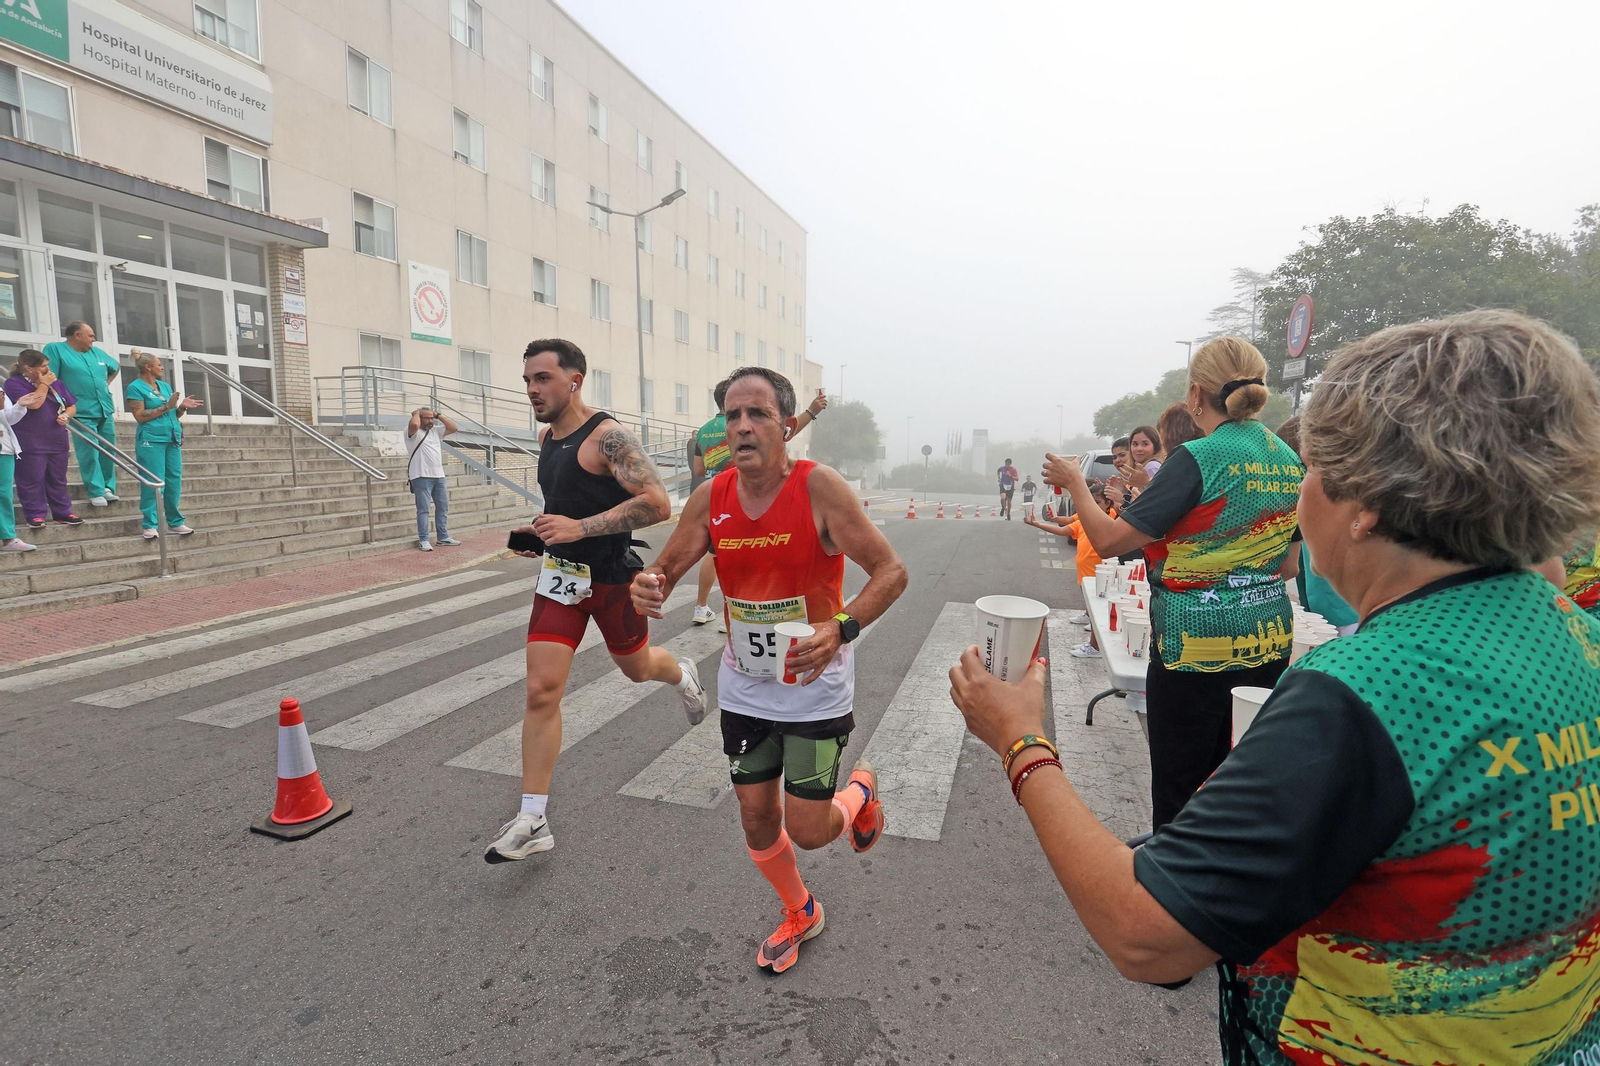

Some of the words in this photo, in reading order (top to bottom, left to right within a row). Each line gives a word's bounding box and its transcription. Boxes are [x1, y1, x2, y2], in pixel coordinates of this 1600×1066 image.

[8, 11, 20, 20] de
[21, 16, 63, 38] Andalucía
[82, 22, 142, 57] Hospital
[144, 50, 221, 91] Universitario
[224, 86, 237, 98] de
[239, 93, 266, 111] Jerez
[83, 44, 142, 78] Hospital
[145, 70, 196, 100] Materno
[206, 96, 244, 120] Infantil
[1228, 463, 1241, 477] X
[1244, 462, 1281, 476] MILLA
[1246, 480, 1280, 493] PILAR
[718, 532, 792, 550] ESPAÑA
[758, 599, 799, 611] SOLIDARIA
[1478, 736, 1530, 777] X
